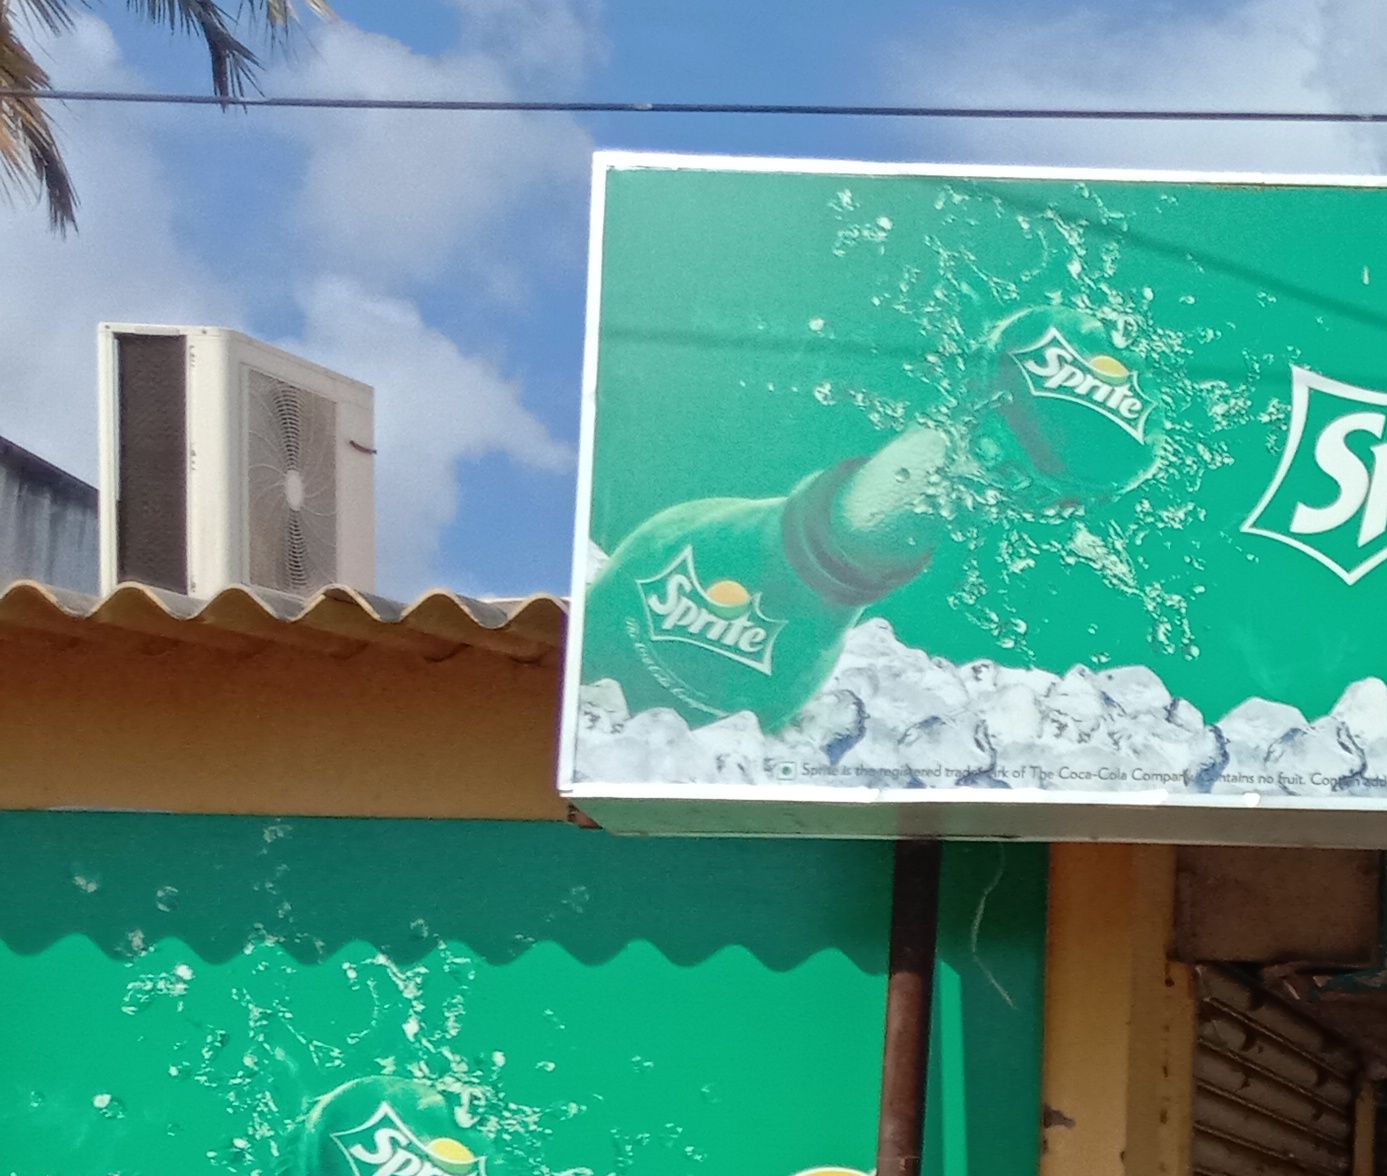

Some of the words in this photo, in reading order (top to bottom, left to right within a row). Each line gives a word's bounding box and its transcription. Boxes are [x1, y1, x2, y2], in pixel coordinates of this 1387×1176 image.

[1023, 338, 1144, 420] Sprite
[648, 574, 767, 652] Sprite
[1012, 766, 1026, 779] of
[1029, 766, 1054, 780] The
[1058, 767, 1127, 781] Coca-Cola
[1258, 776, 1274, 785] no
